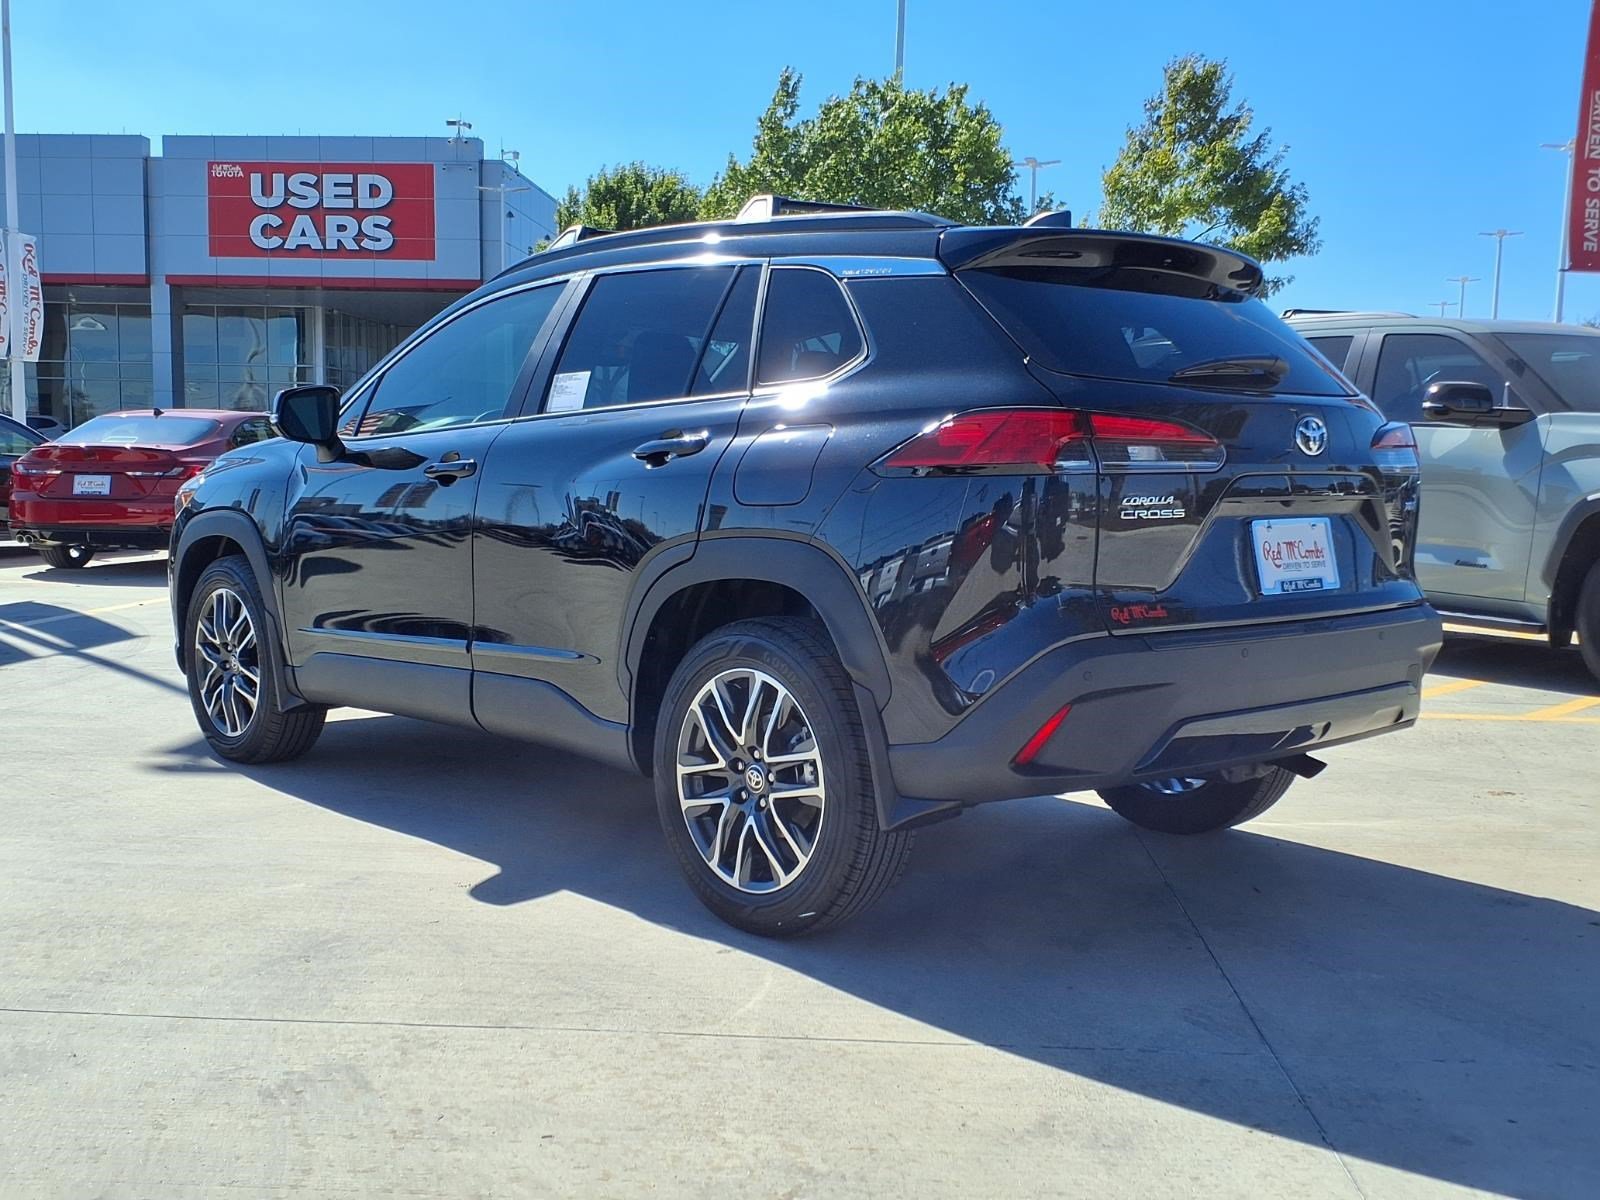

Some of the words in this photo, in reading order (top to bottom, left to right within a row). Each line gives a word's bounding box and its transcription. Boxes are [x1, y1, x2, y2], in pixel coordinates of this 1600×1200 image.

[211, 170, 244, 178] TOYOTA
[1587, 168, 1600, 192] TO
[249, 172, 393, 209] USED
[249, 213, 394, 251] CARS
[1584, 198, 1600, 251] SERVE
[23, 311, 29, 324] TO
[26, 285, 41, 355] McCombs
[1121, 495, 1175, 506] COROLLA
[1120, 508, 1186, 519] CROSS
[1262, 540, 1283, 569] Red
[1281, 539, 1324, 561] McCombs
[1302, 561, 1310, 569] TO
